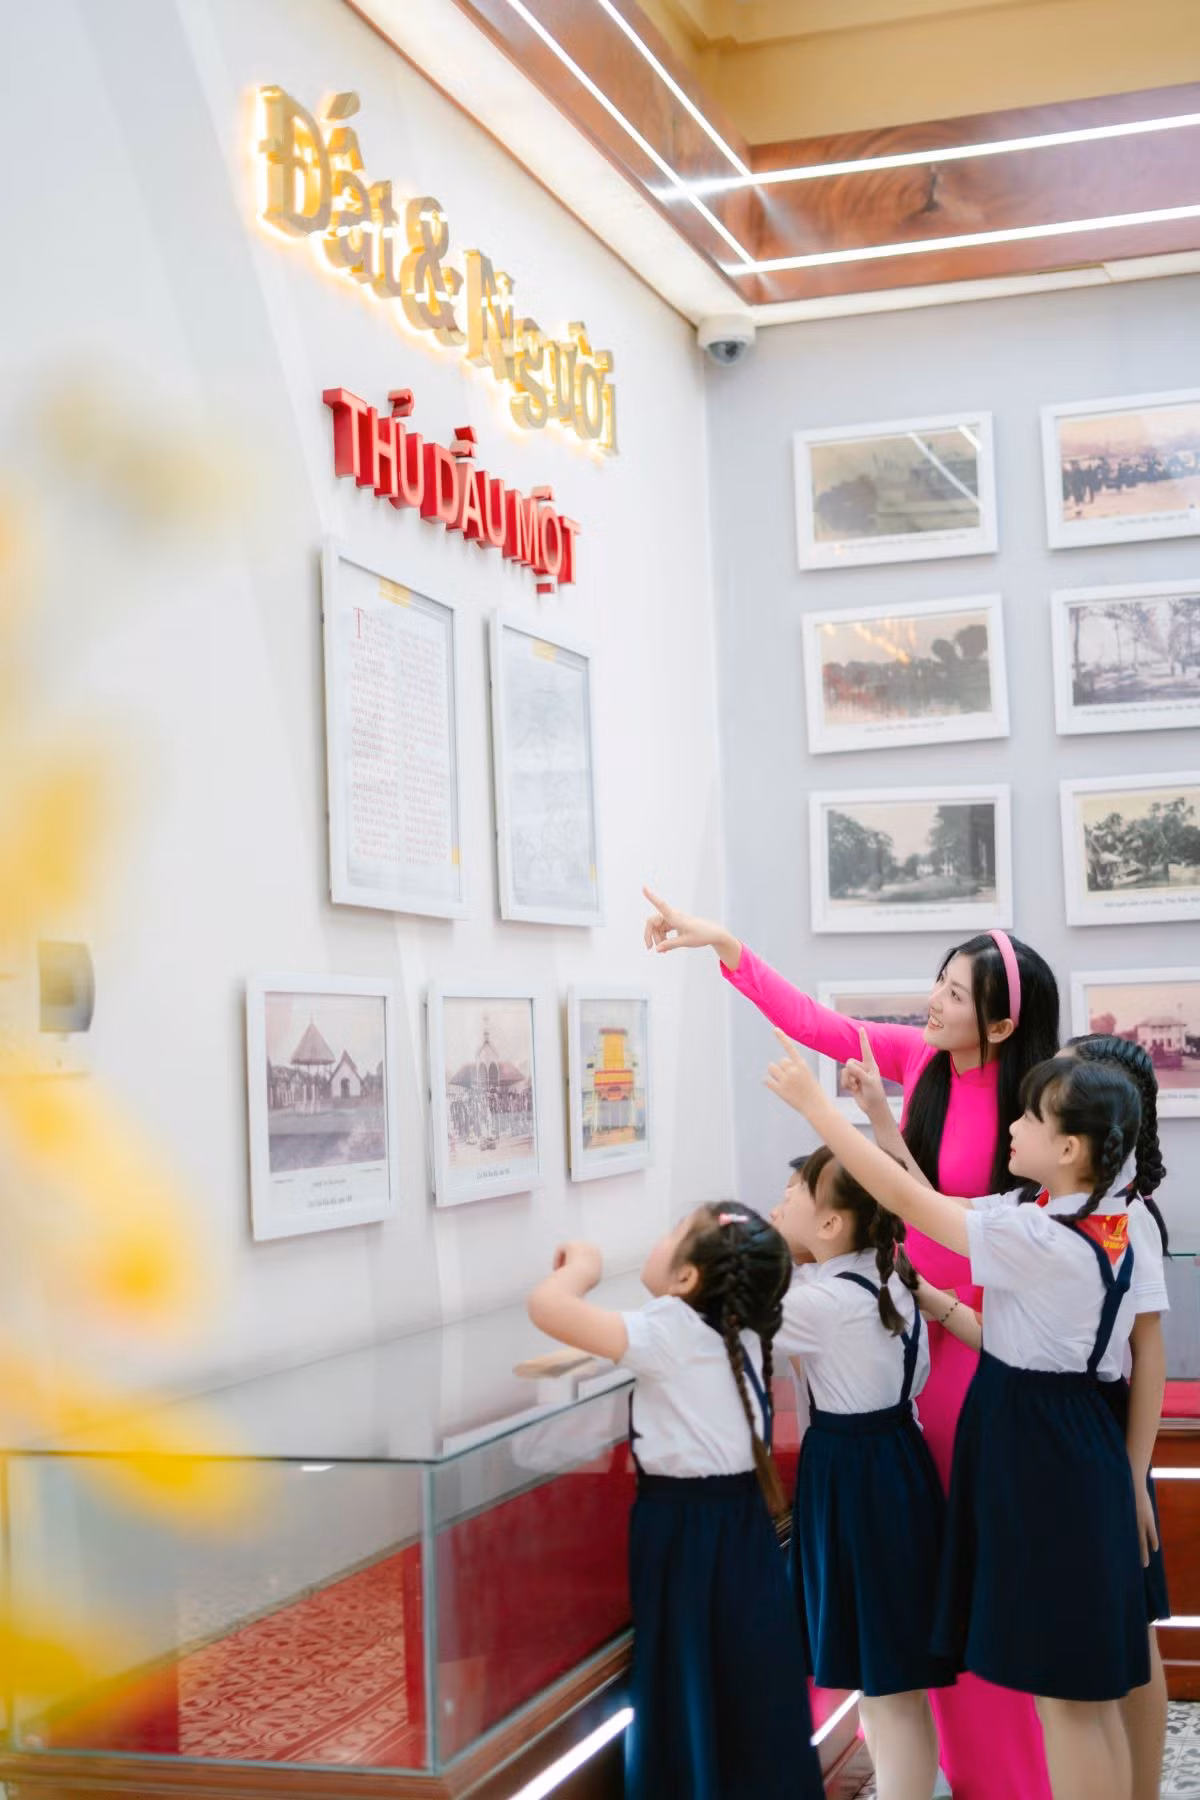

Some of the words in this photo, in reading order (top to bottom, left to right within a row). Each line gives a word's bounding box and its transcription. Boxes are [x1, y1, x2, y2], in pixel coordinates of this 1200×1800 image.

[257, 84, 402, 298] Đất
[400, 196, 467, 345] &
[463, 249, 618, 454] Người
[322, 387, 424, 509] THỦ
[420, 425, 507, 549] DẦU
[502, 485, 581, 594] MỘT
